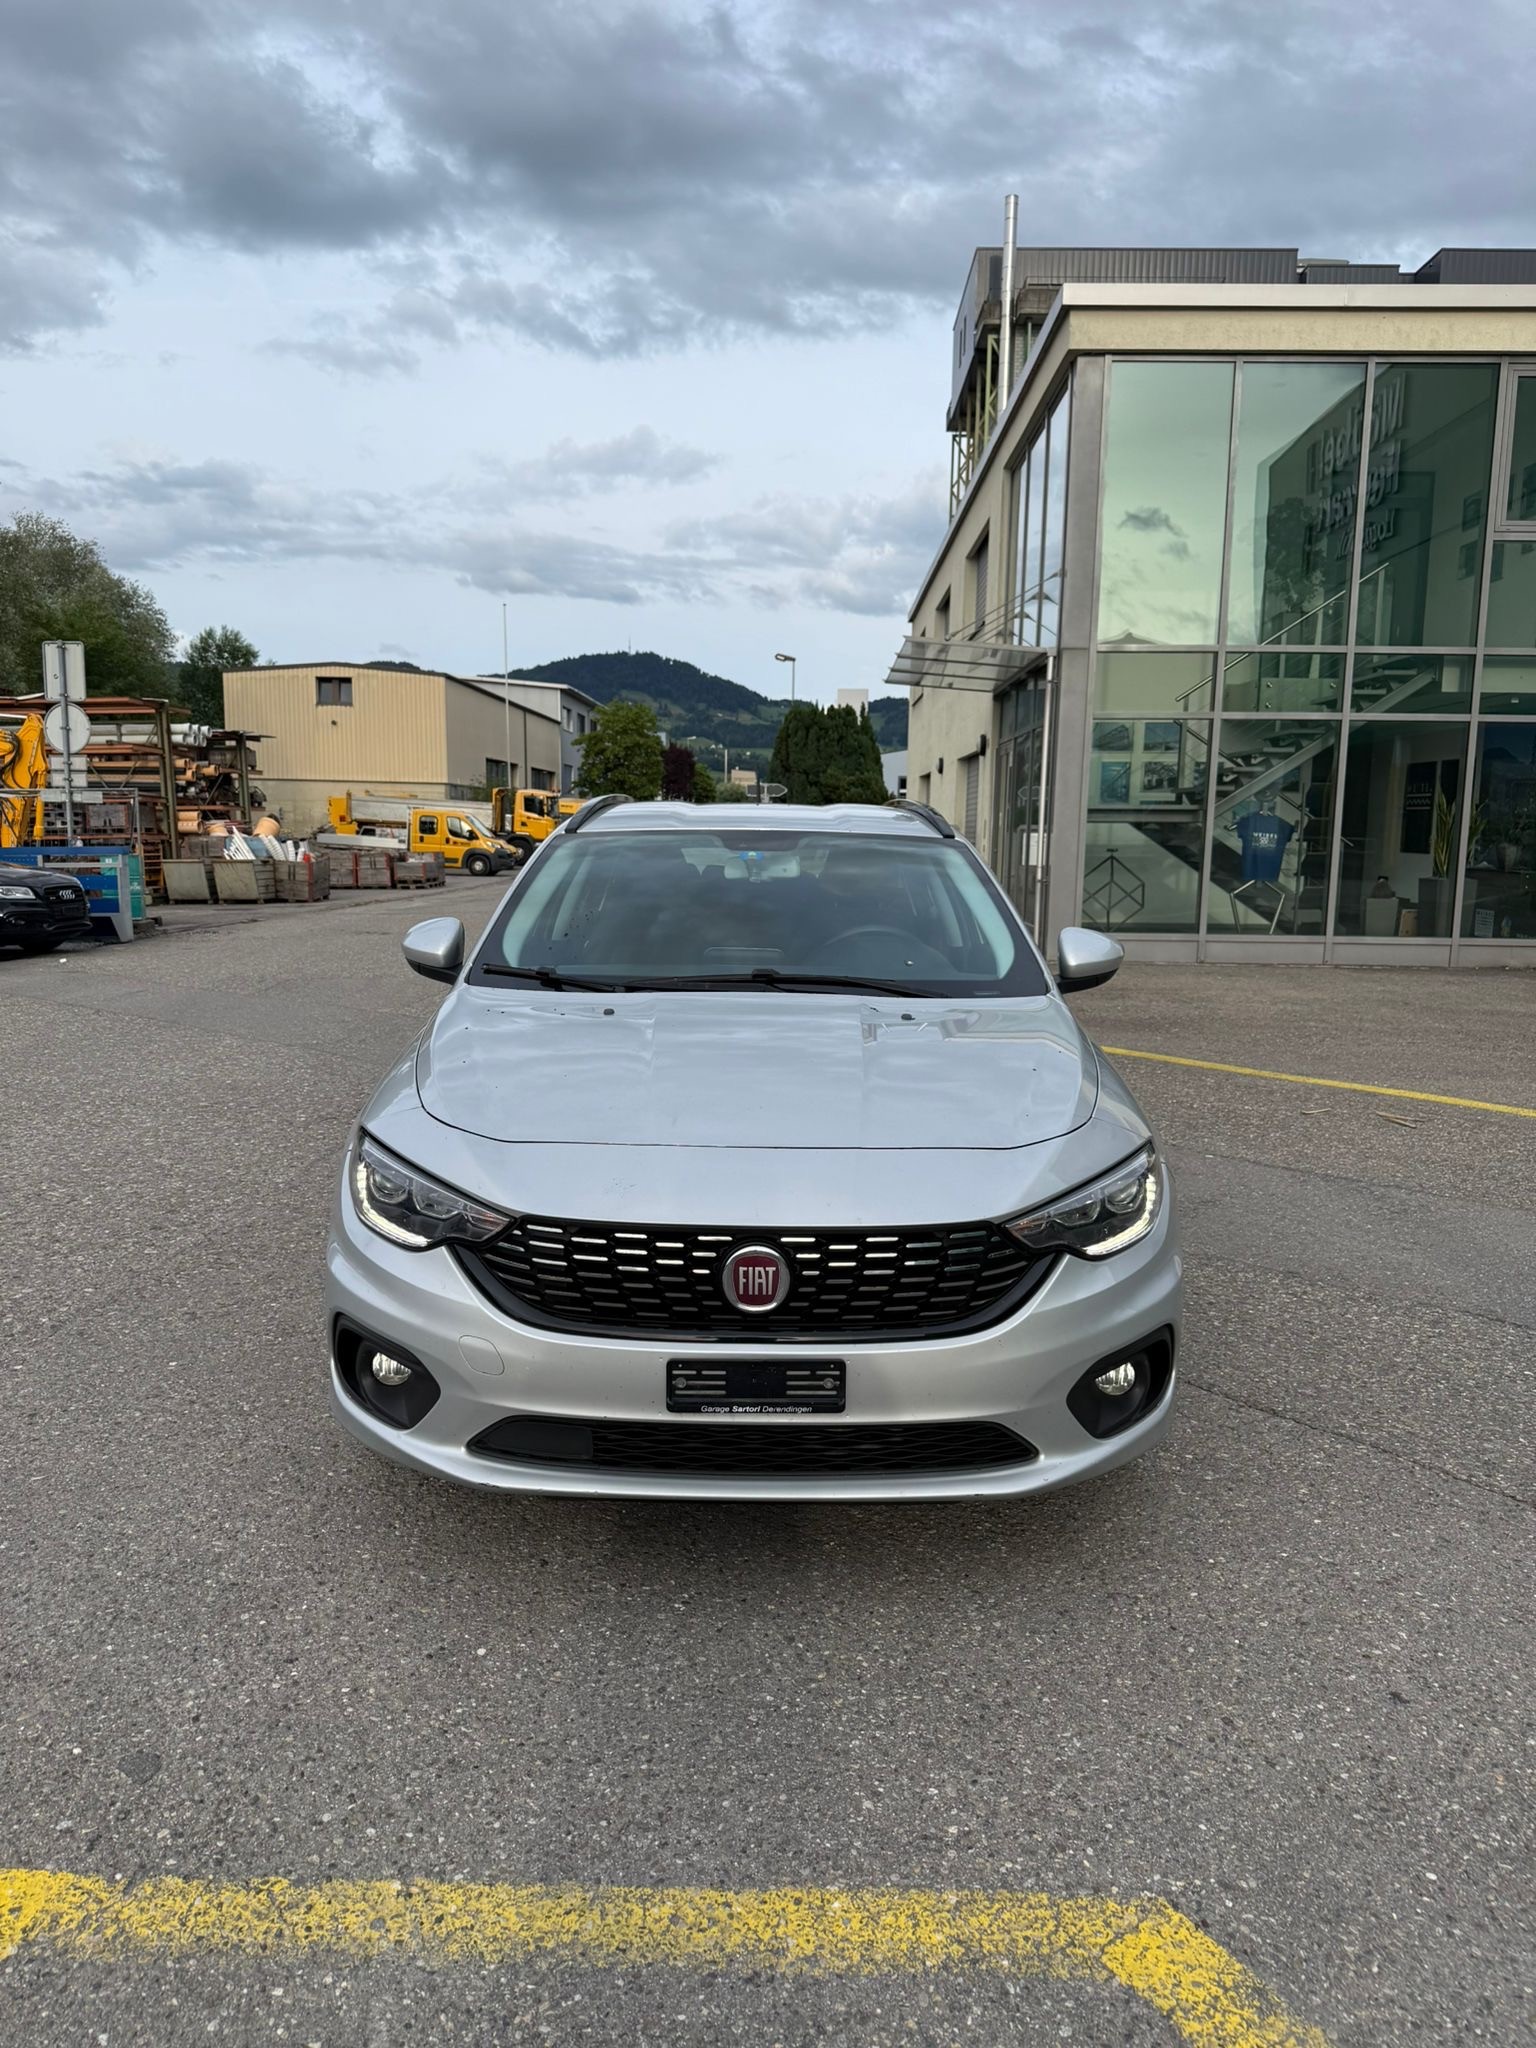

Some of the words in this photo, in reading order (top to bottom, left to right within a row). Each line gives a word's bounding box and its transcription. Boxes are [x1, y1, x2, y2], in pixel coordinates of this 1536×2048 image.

[738, 1266, 776, 1296] FIAT
[701, 1405, 730, 1413] Garage
[732, 1405, 761, 1413] Sartori
[762, 1405, 812, 1413] Derendingen
